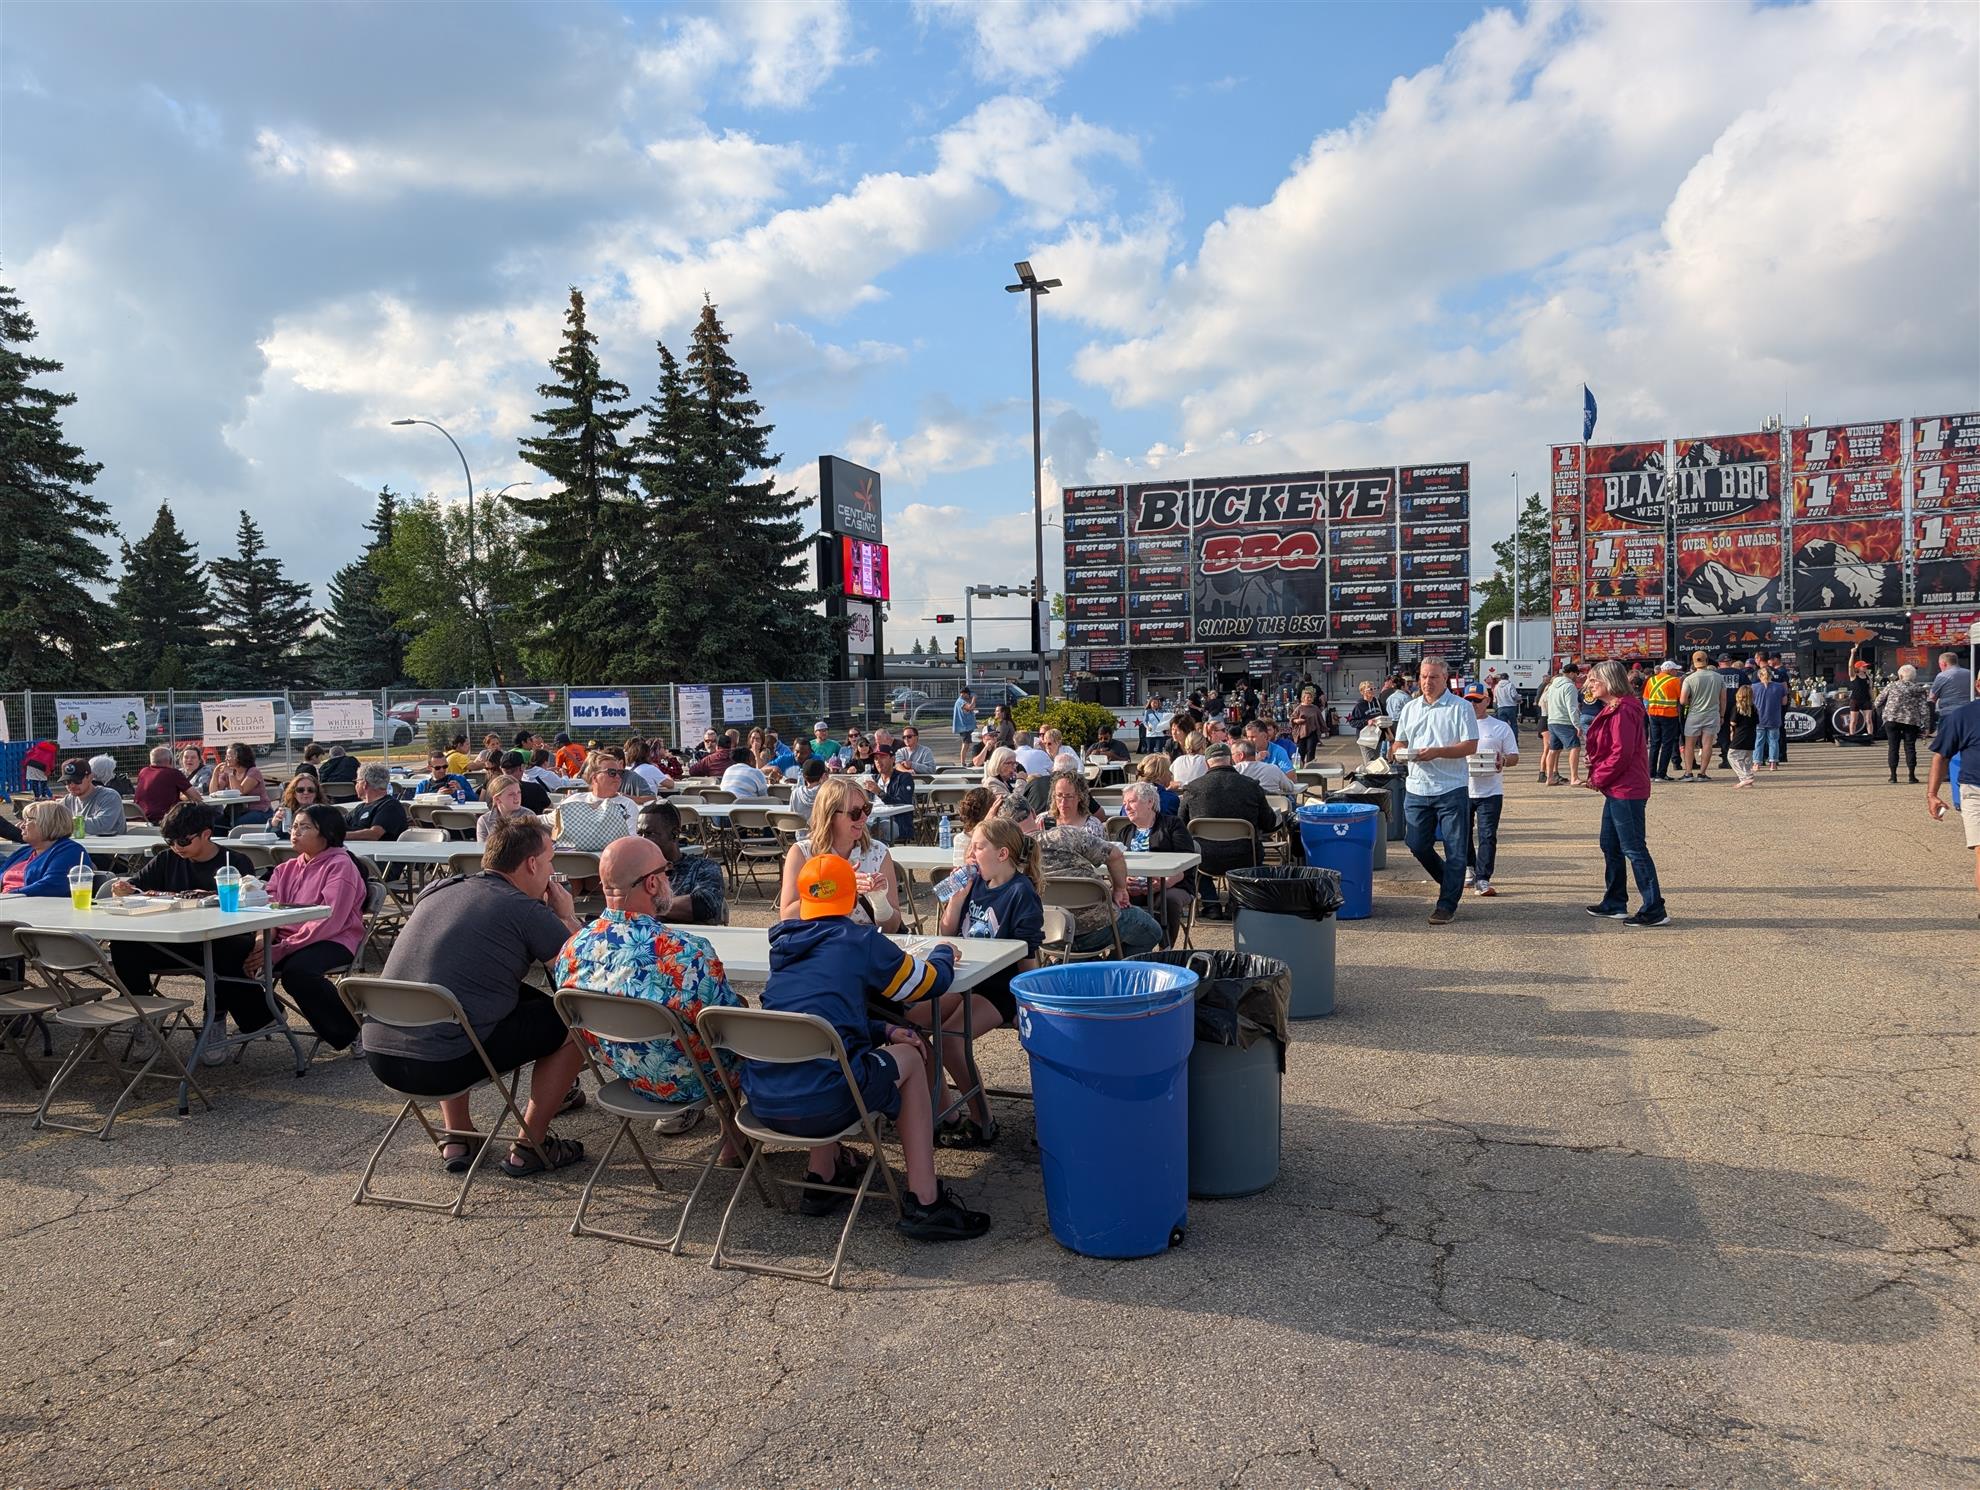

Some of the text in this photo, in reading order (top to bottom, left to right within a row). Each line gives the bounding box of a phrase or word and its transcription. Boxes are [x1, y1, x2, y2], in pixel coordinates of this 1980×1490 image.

[1952, 418, 1961, 426] ST
[1846, 425, 1884, 437] WINNIPEG
[1917, 419, 1950, 451] 1ST
[1805, 430, 1836, 461] 1ST
[1849, 437, 1882, 448] BEST
[1849, 447, 1881, 458] RIBS
[1413, 469, 1438, 477] BEST
[1554, 471, 1579, 479] LEDUC
[1844, 473, 1860, 482] FORT
[1875, 471, 1892, 479] JOHN
[1719, 466, 1769, 500] BBQ
[1917, 466, 1950, 498] 1ST
[1807, 475, 1837, 506] 1ST
[1854, 483, 1883, 493] BEST
[1075, 490, 1096, 498] BEST
[1850, 493, 1888, 502] SAUCE
[1135, 477, 1391, 533] BUCKEYE
[1413, 497, 1438, 505] BEST
[1704, 501, 1734, 512] TOUR
[838, 504, 877, 523] CENTURY
[844, 516, 877, 534] CASINO
[1340, 530, 1365, 538] BEST
[1919, 518, 1951, 549] 1ST
[1553, 541, 1579, 549] CALGARY
[1625, 538, 1658, 546] SASKATOON
[1682, 533, 1777, 551] OVER 300 AWARDS
[1592, 539, 1620, 567] 1ST
[1628, 549, 1654, 557] BEST
[1341, 558, 1365, 566] BEST
[1414, 555, 1439, 563] BEST
[1628, 558, 1653, 566] RIBS
[1923, 592, 1975, 603] FAMOUS BEEF
[1554, 612, 1579, 620] CALGARY
[1198, 614, 1326, 636] SIMPLY THE BEST
[573, 705, 626, 717] Kid's Zone
[230, 716, 264, 725] KELDAR
[969, 900, 989, 921] Stitch
